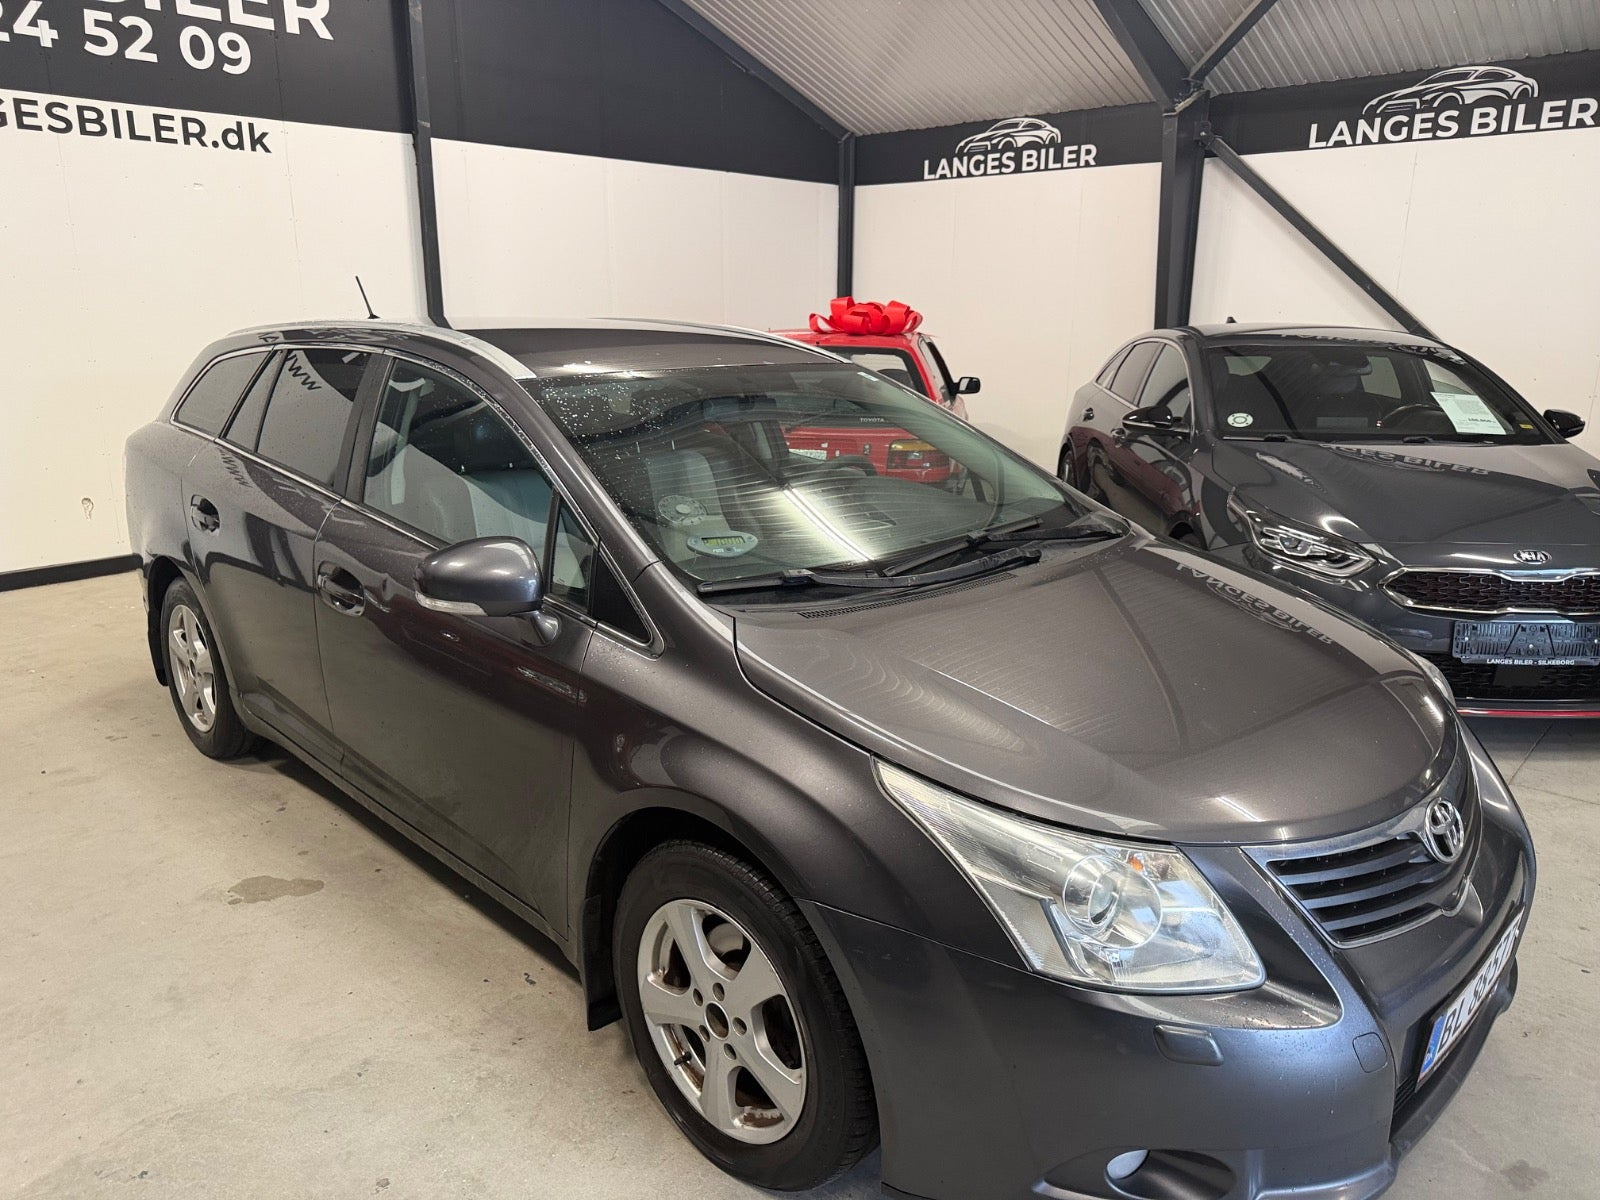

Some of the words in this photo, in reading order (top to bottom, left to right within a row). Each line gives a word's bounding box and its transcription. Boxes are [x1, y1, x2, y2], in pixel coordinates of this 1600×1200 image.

[83, 8, 158, 63] 52
[179, 25, 251, 75] 09
[0, 97, 272, 153] ESBILER.dk
[1307, 109, 1460, 149] LANGES
[1470, 97, 1599, 136] BILER
[923, 151, 1016, 181] LANGES
[1021, 143, 1098, 172] BILER
[1437, 997, 1466, 1053] BL
